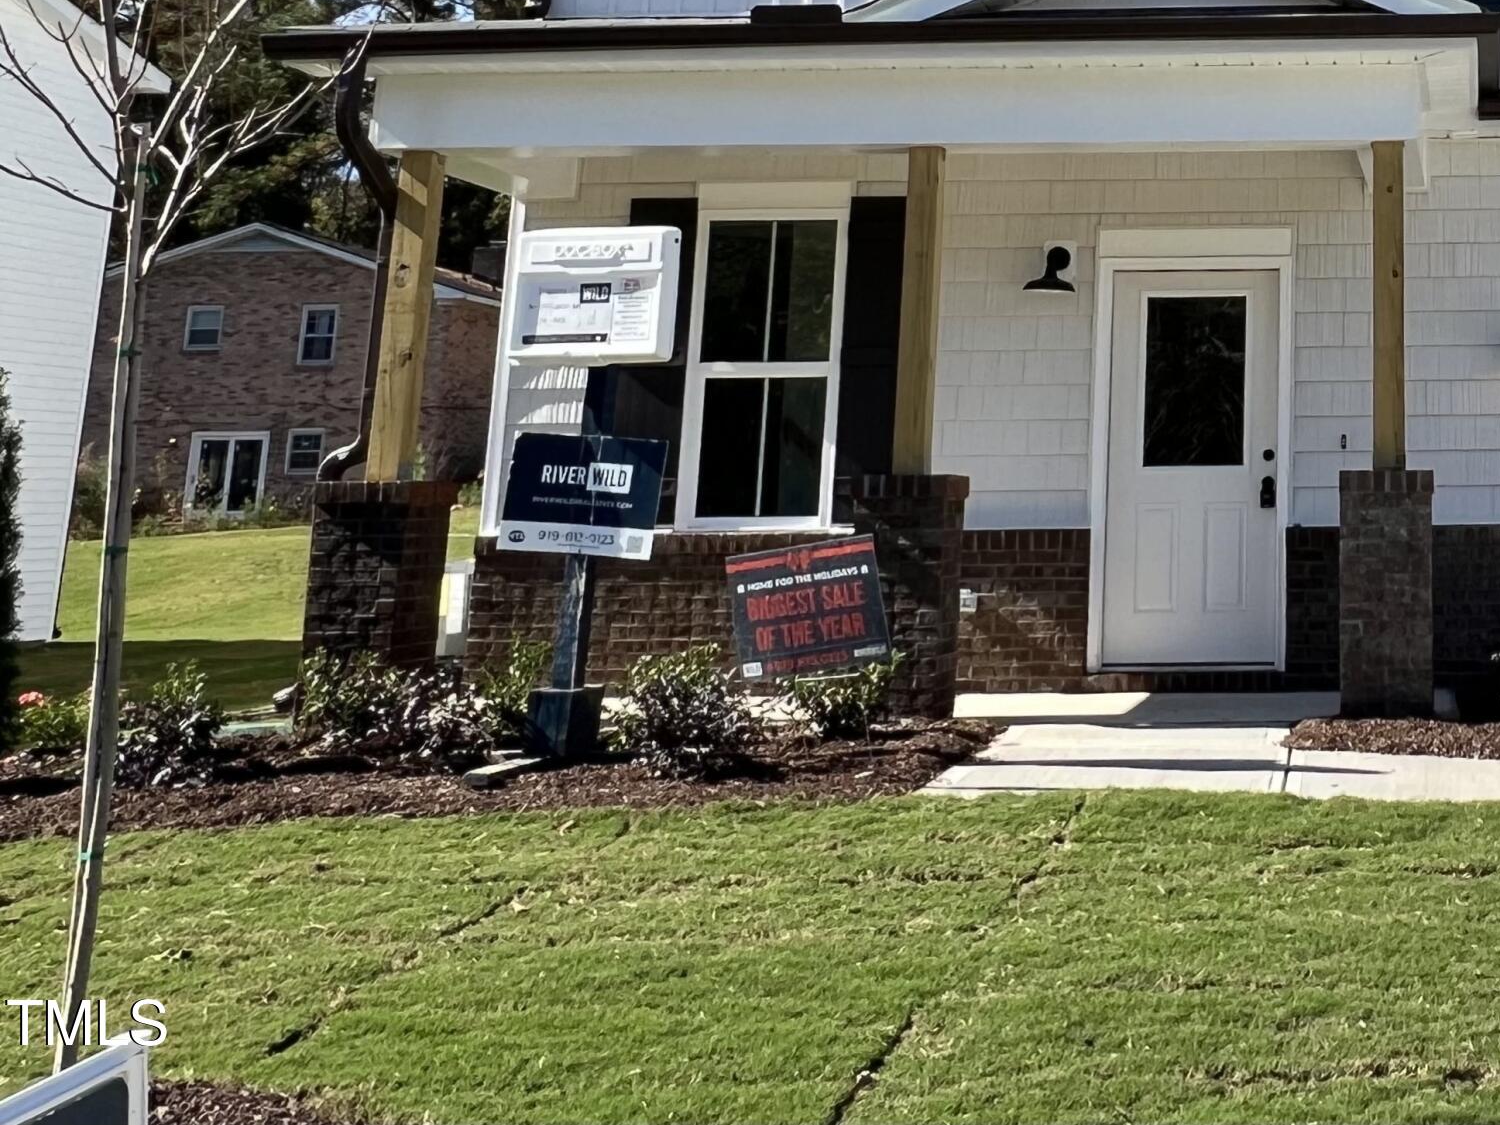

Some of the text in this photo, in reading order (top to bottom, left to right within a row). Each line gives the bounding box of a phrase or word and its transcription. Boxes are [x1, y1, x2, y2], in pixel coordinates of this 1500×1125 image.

[582, 287, 609, 301] WILD
[540, 464, 628, 487] RIVER WILD
[775, 576, 793, 587] FOR
[795, 573, 812, 584] THE
[813, 565, 858, 581] HOLIDAYS
[746, 580, 866, 622] BIGGEST SALE
[754, 612, 866, 652] OF THE YEAR
